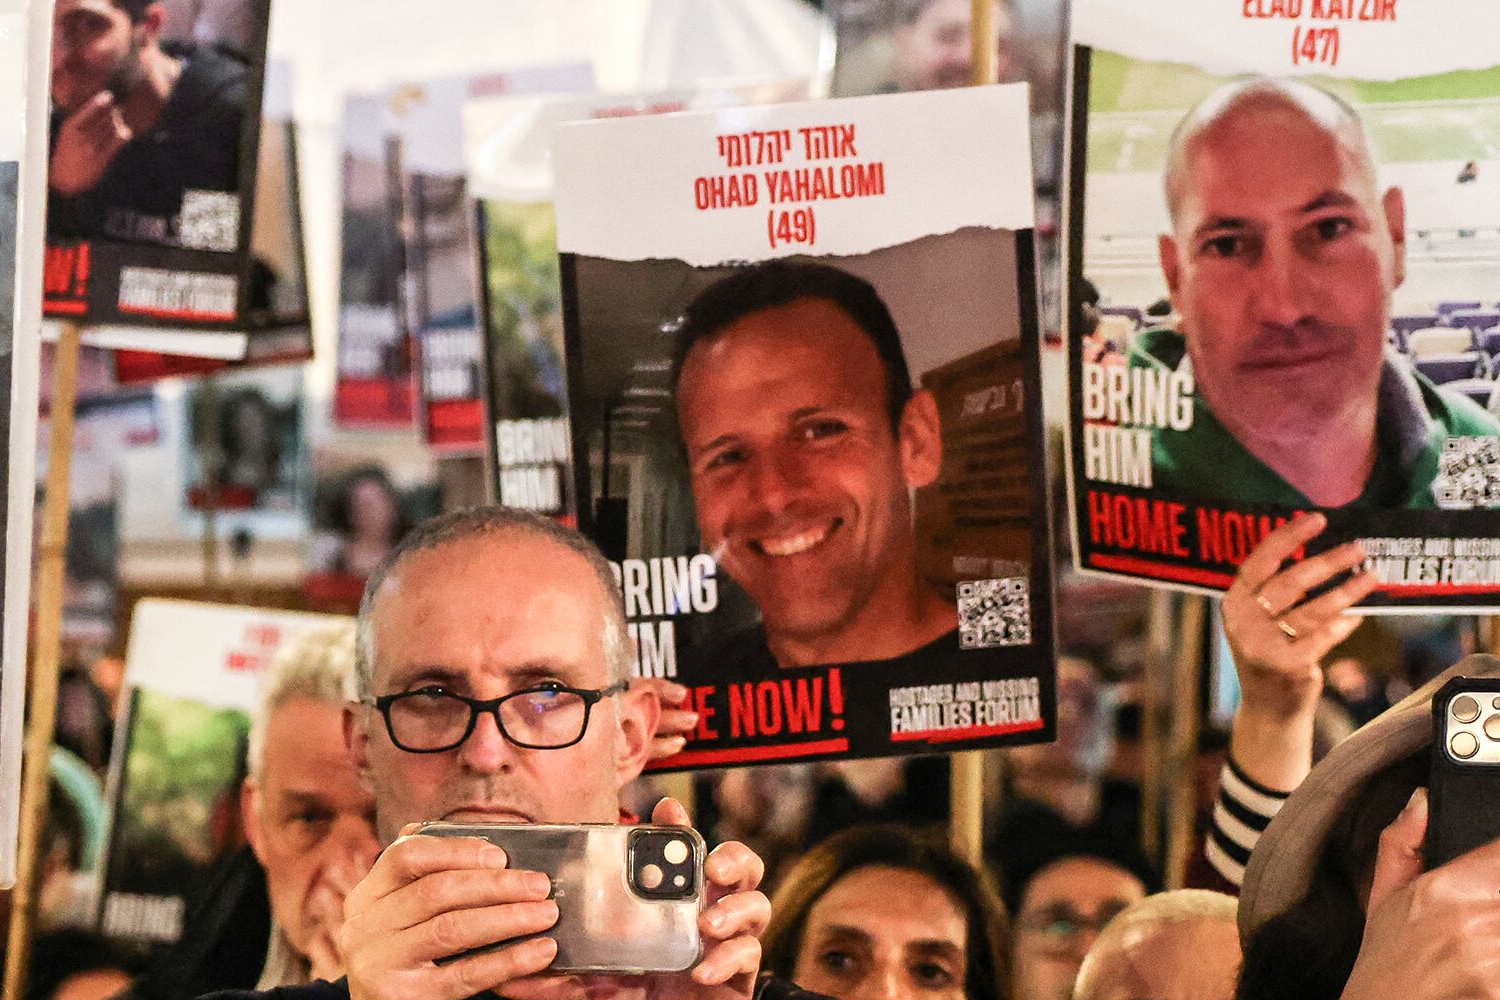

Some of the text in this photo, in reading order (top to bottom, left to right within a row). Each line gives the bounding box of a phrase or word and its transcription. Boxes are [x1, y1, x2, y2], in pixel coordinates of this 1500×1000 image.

[1242, 0, 1397, 20] ELAD KATZIR
[1291, 26, 1342, 66] (47)
[716, 123, 857, 168] אוהד יהלומי
[694, 162, 886, 210] OHAD YAHALOMI
[767, 208, 817, 249] (49)
[1083, 362, 1194, 431] BRING
[1084, 424, 1153, 489] HIM
[1088, 490, 1190, 558] HOME
[729, 667, 847, 739] NOW!
[890, 696, 1041, 733] FAMILIES FORUM
